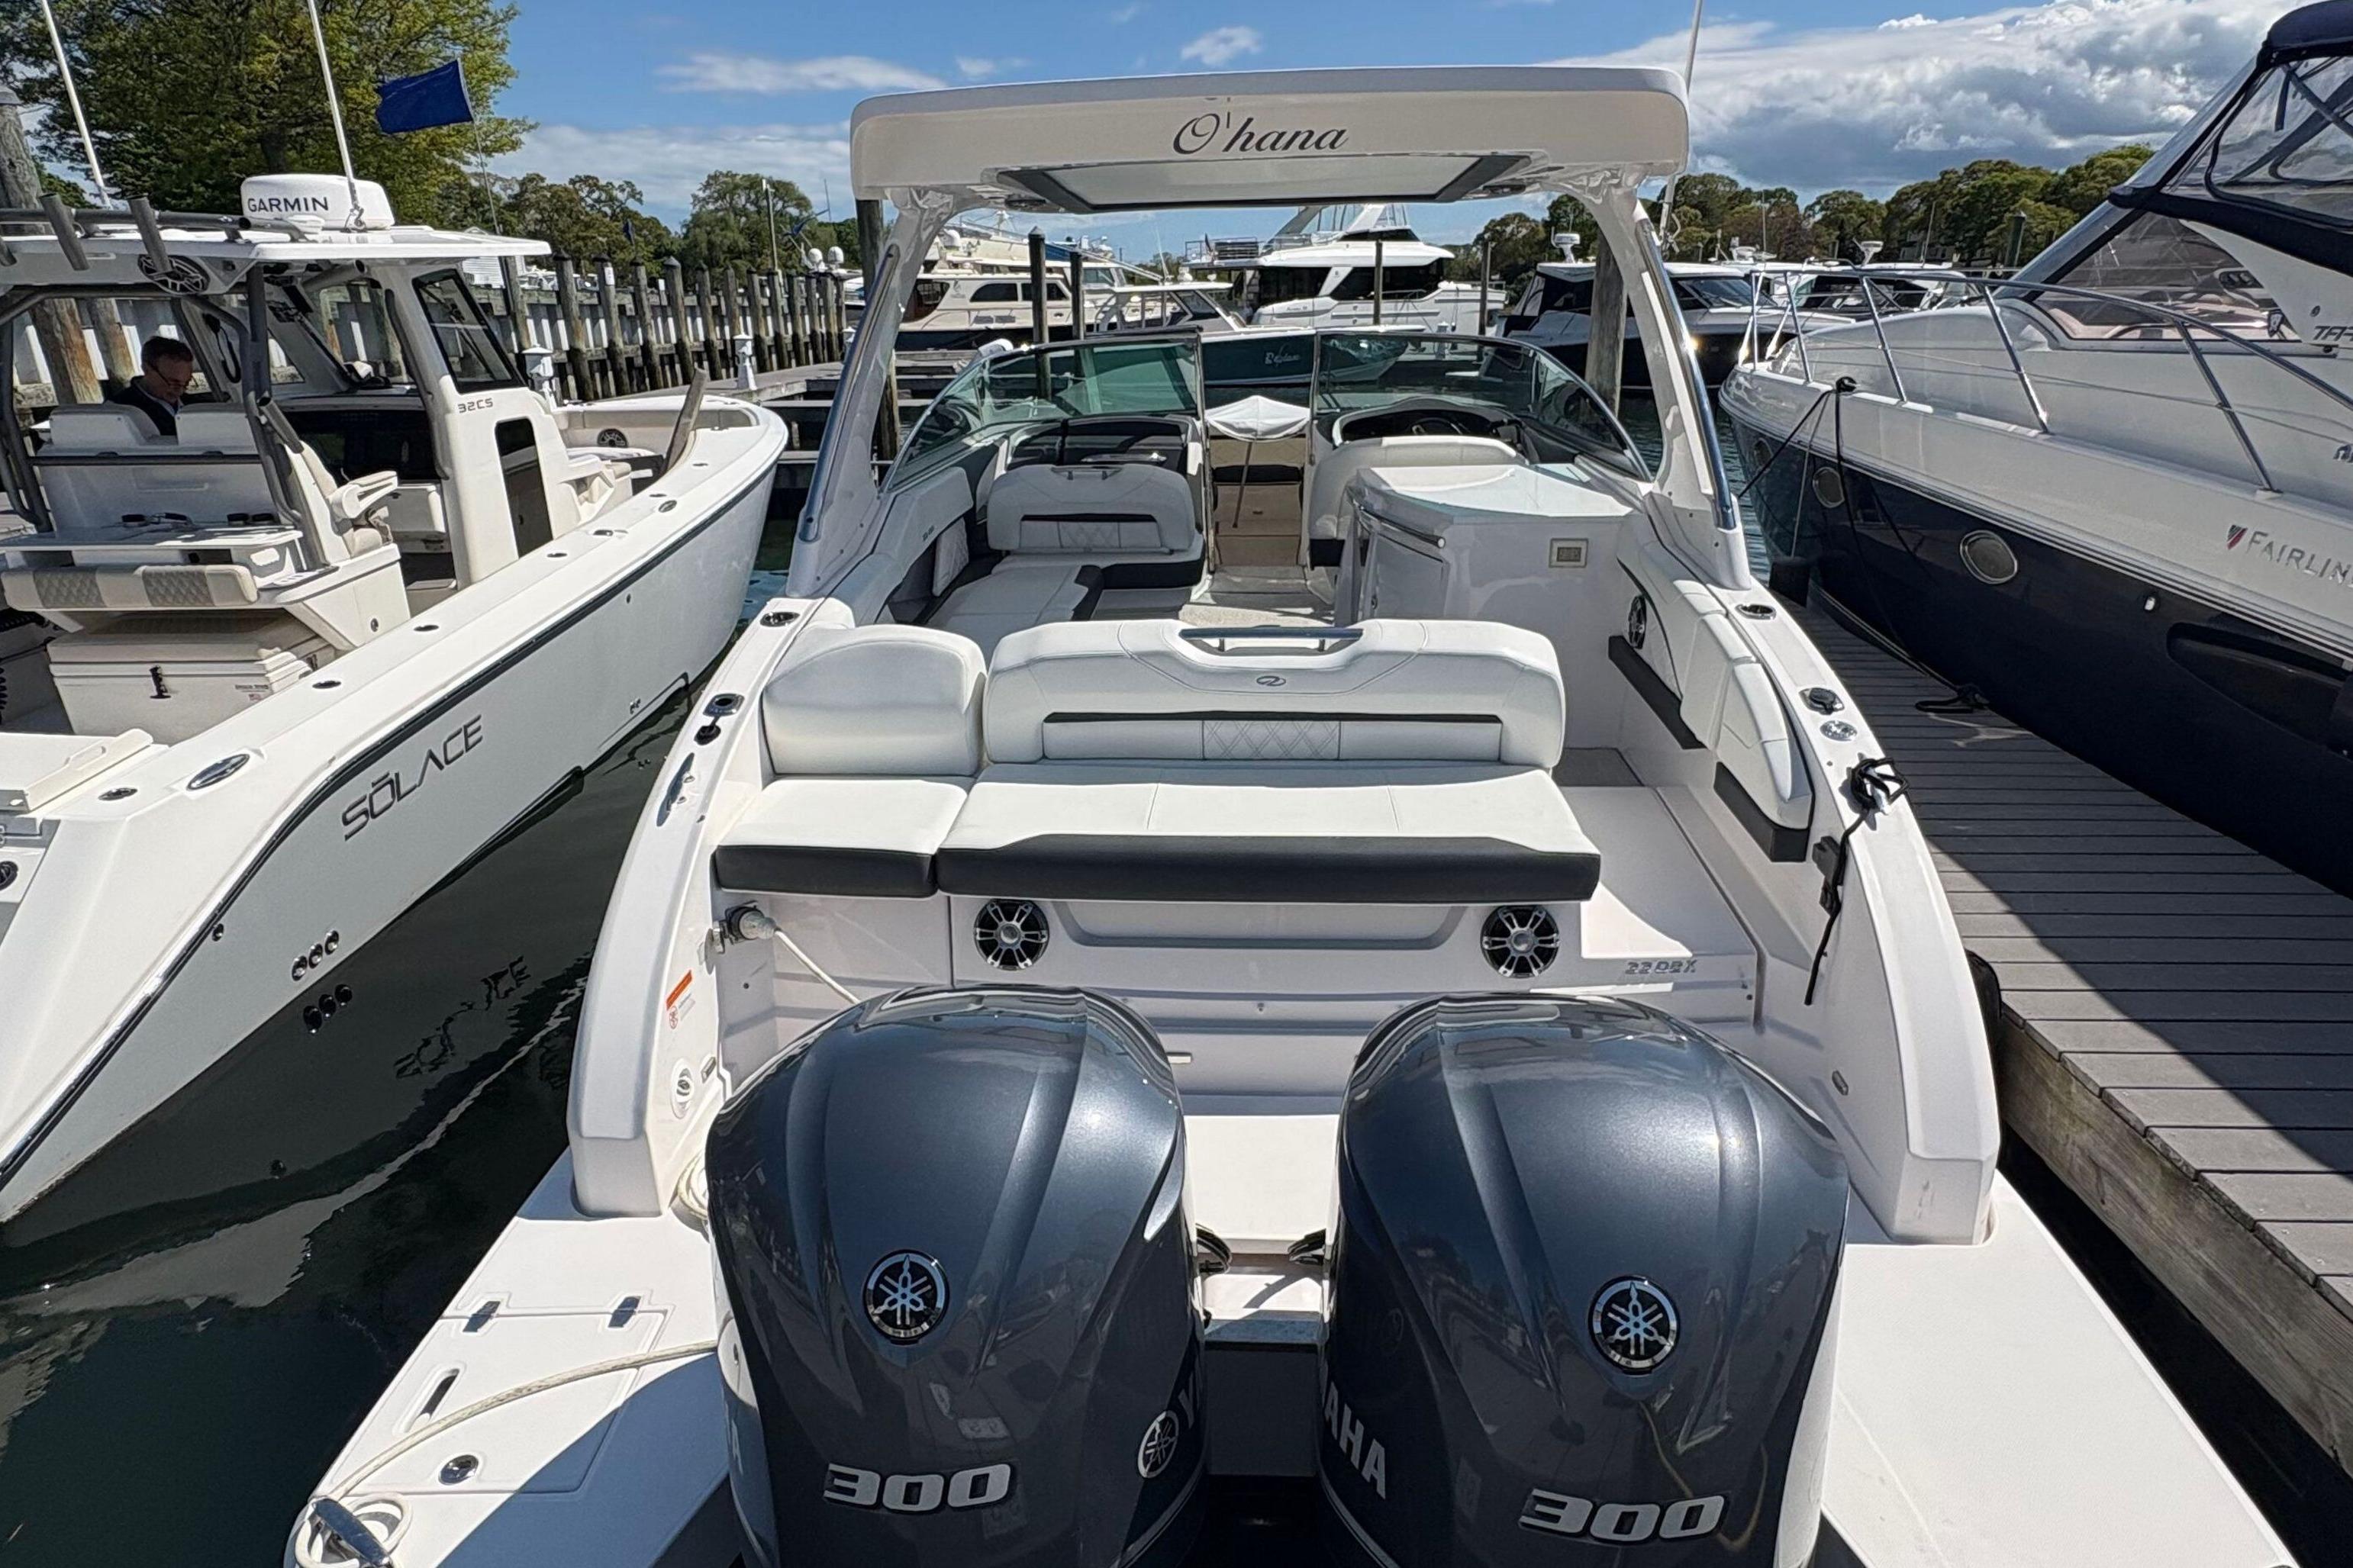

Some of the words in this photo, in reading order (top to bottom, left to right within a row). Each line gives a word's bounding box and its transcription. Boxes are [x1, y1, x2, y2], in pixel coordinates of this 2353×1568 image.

[1173, 112, 1349, 154] O'hana
[247, 197, 328, 212] GARMIN
[458, 398, 493, 413] 32CS
[2246, 530, 2353, 588] FAIRLIN
[824, 1463, 1011, 1512] 300
[1519, 1489, 1725, 1541] 300
